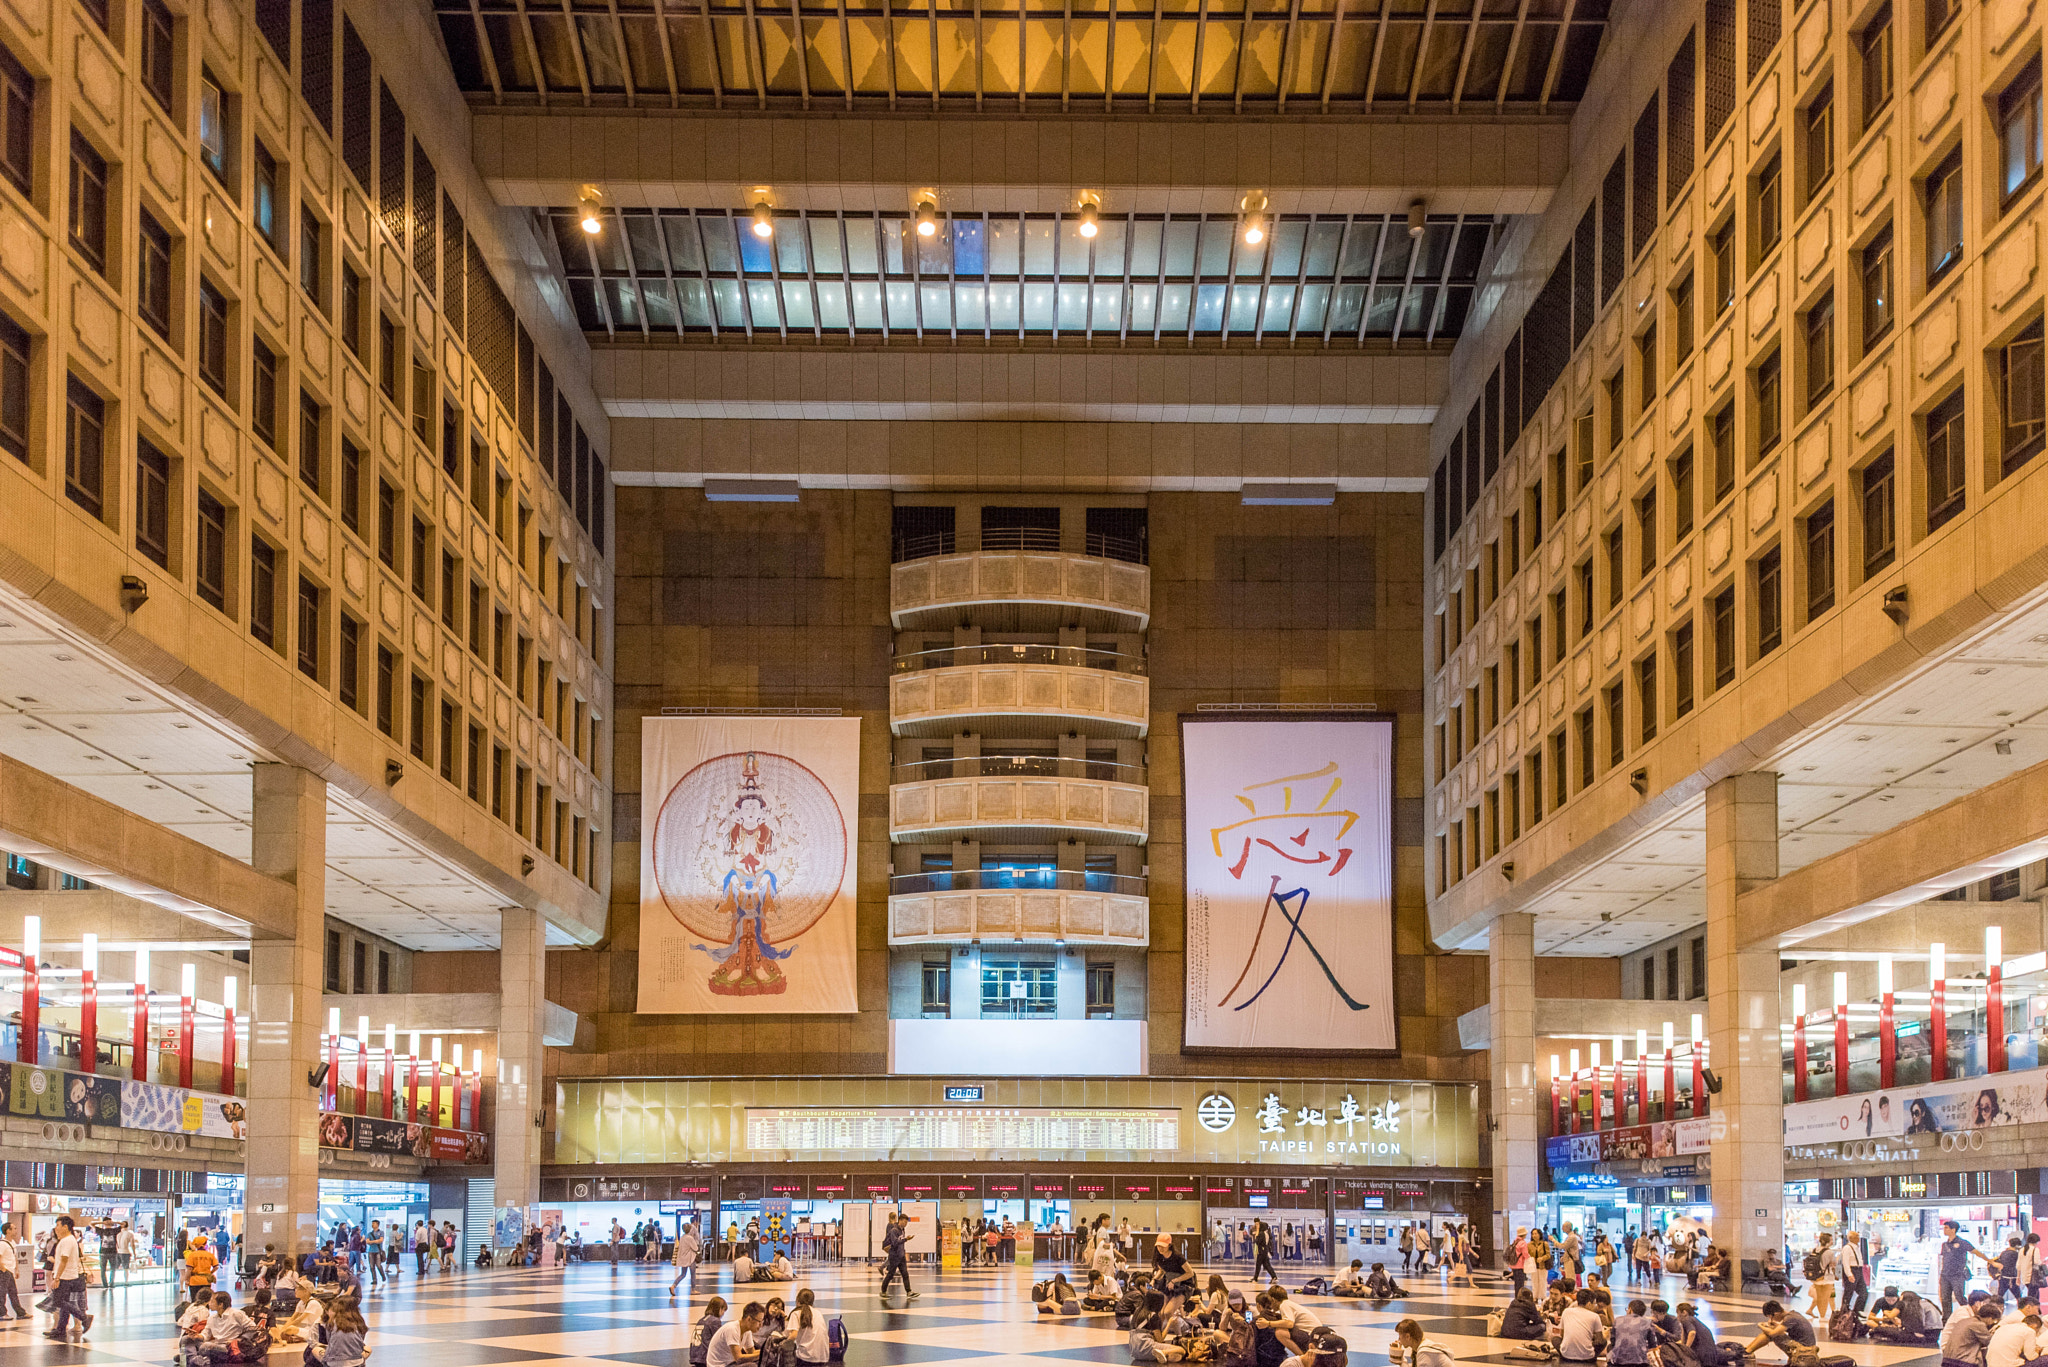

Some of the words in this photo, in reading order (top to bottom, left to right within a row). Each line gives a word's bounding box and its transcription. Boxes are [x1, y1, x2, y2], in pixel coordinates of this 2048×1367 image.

[949, 1088, 979, 1099] 20:08
[1255, 1092, 1401, 1138] 臺北車站
[1259, 1140, 1313, 1153] TAIPEI
[1326, 1141, 1401, 1154] STATION
[98, 1173, 123, 1185] Breeze
[599, 1181, 640, 1191] 服務中心
[1344, 1181, 1367, 1189] Tickets
[1369, 1182, 1392, 1190] Vending
[1395, 1182, 1418, 1190] Machine
[1901, 1181, 1926, 1192] Breeze
[263, 1204, 272, 1212] F26
